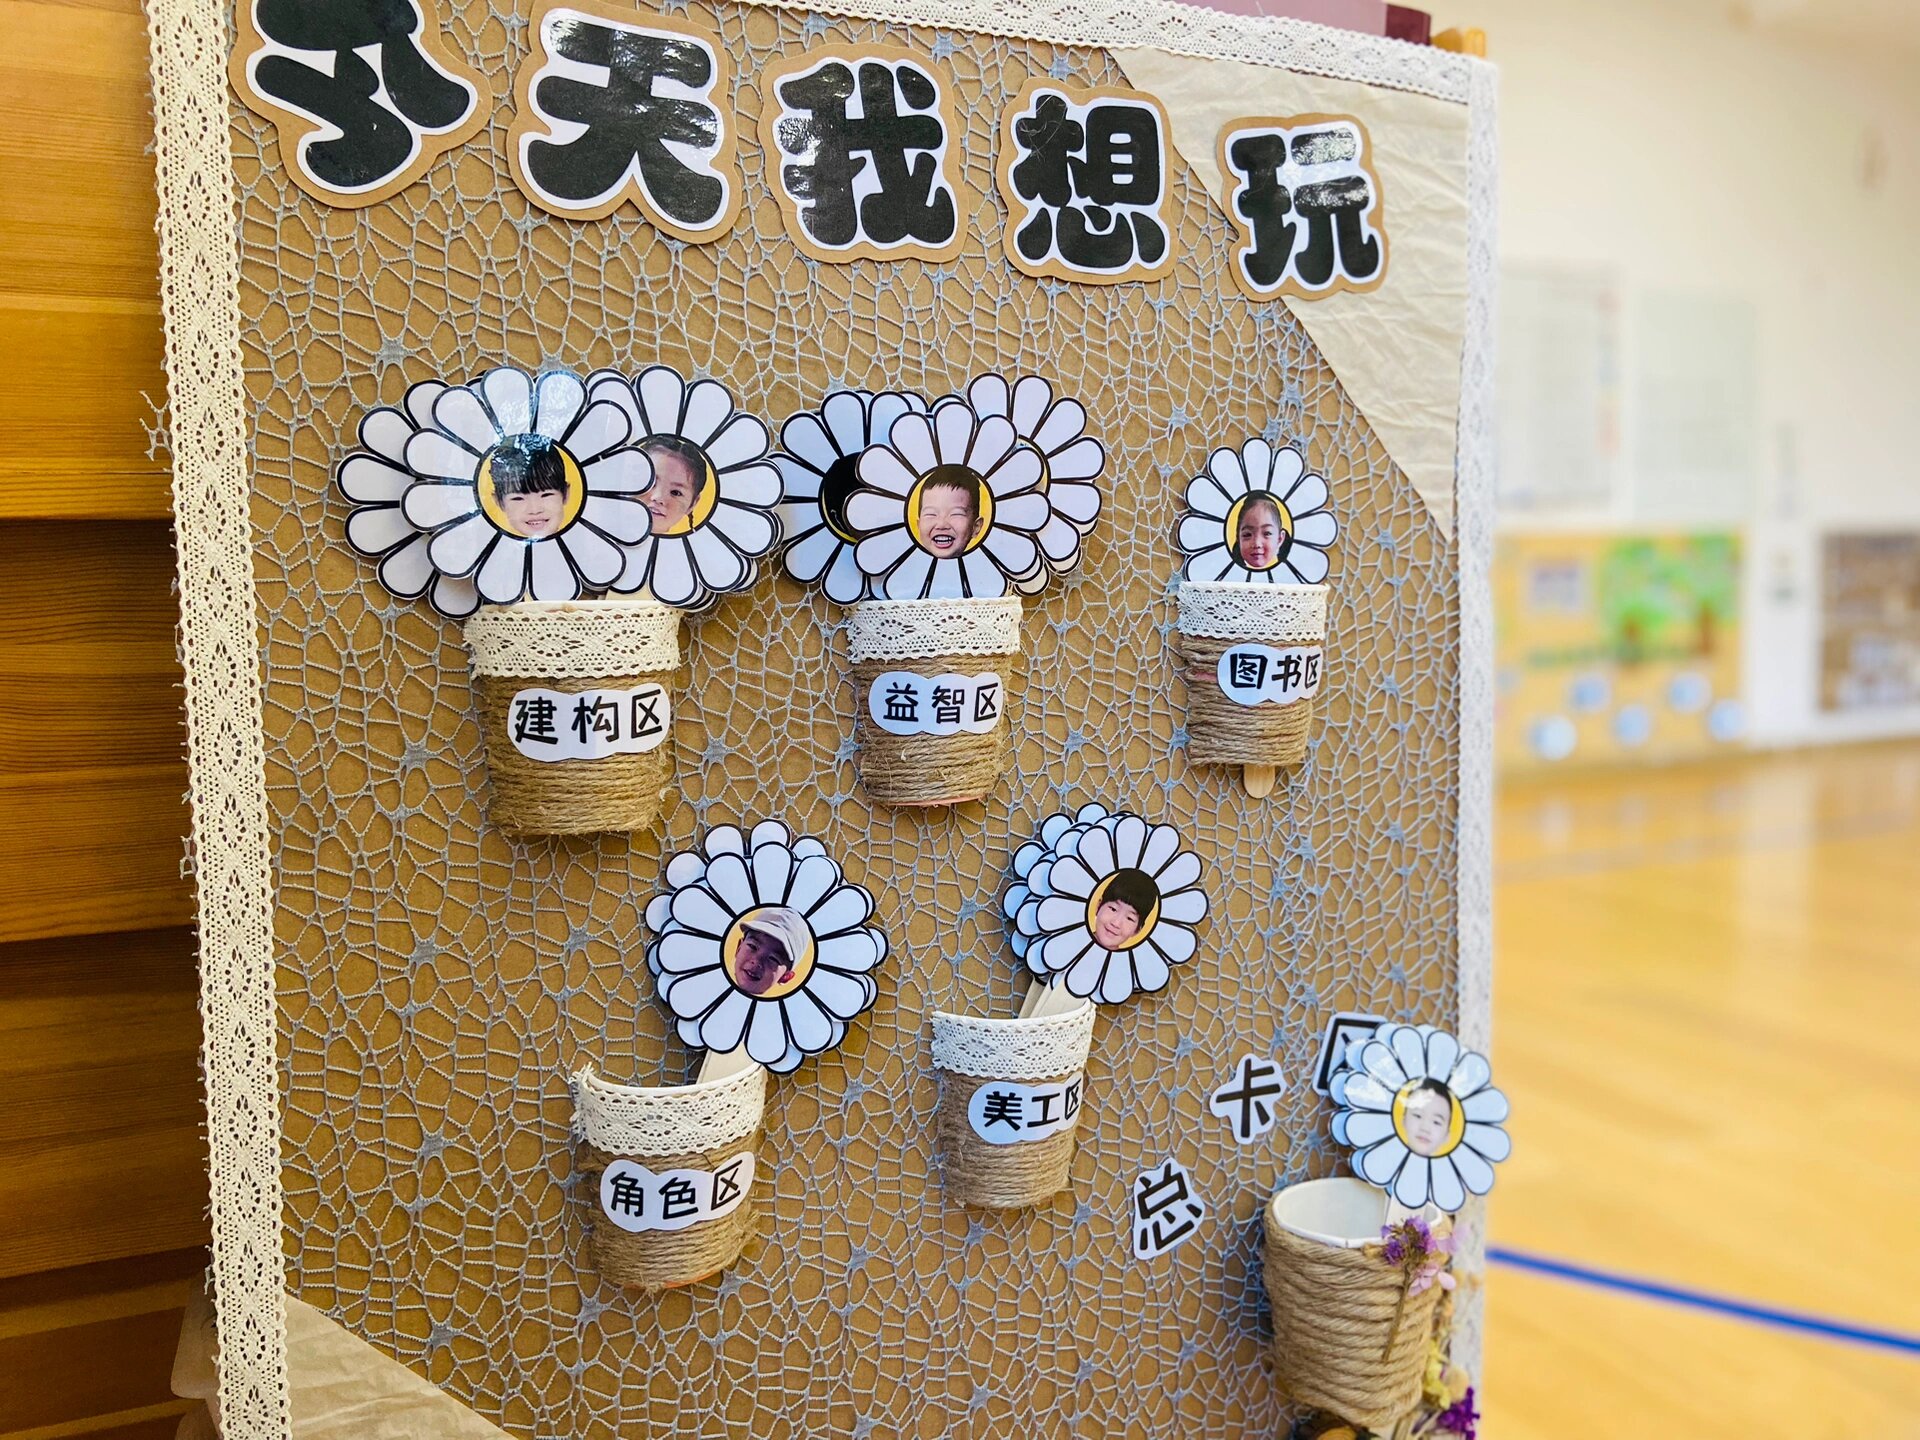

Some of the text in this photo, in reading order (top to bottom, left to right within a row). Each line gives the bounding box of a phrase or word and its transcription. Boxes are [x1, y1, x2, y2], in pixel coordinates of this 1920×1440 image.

[1230, 653, 1321, 692] 图书区
[514, 689, 662, 744] 建构区
[883, 682, 998, 724] 益智区
[983, 1078, 1081, 1131] 美工区
[610, 1159, 743, 1220] 角色区
